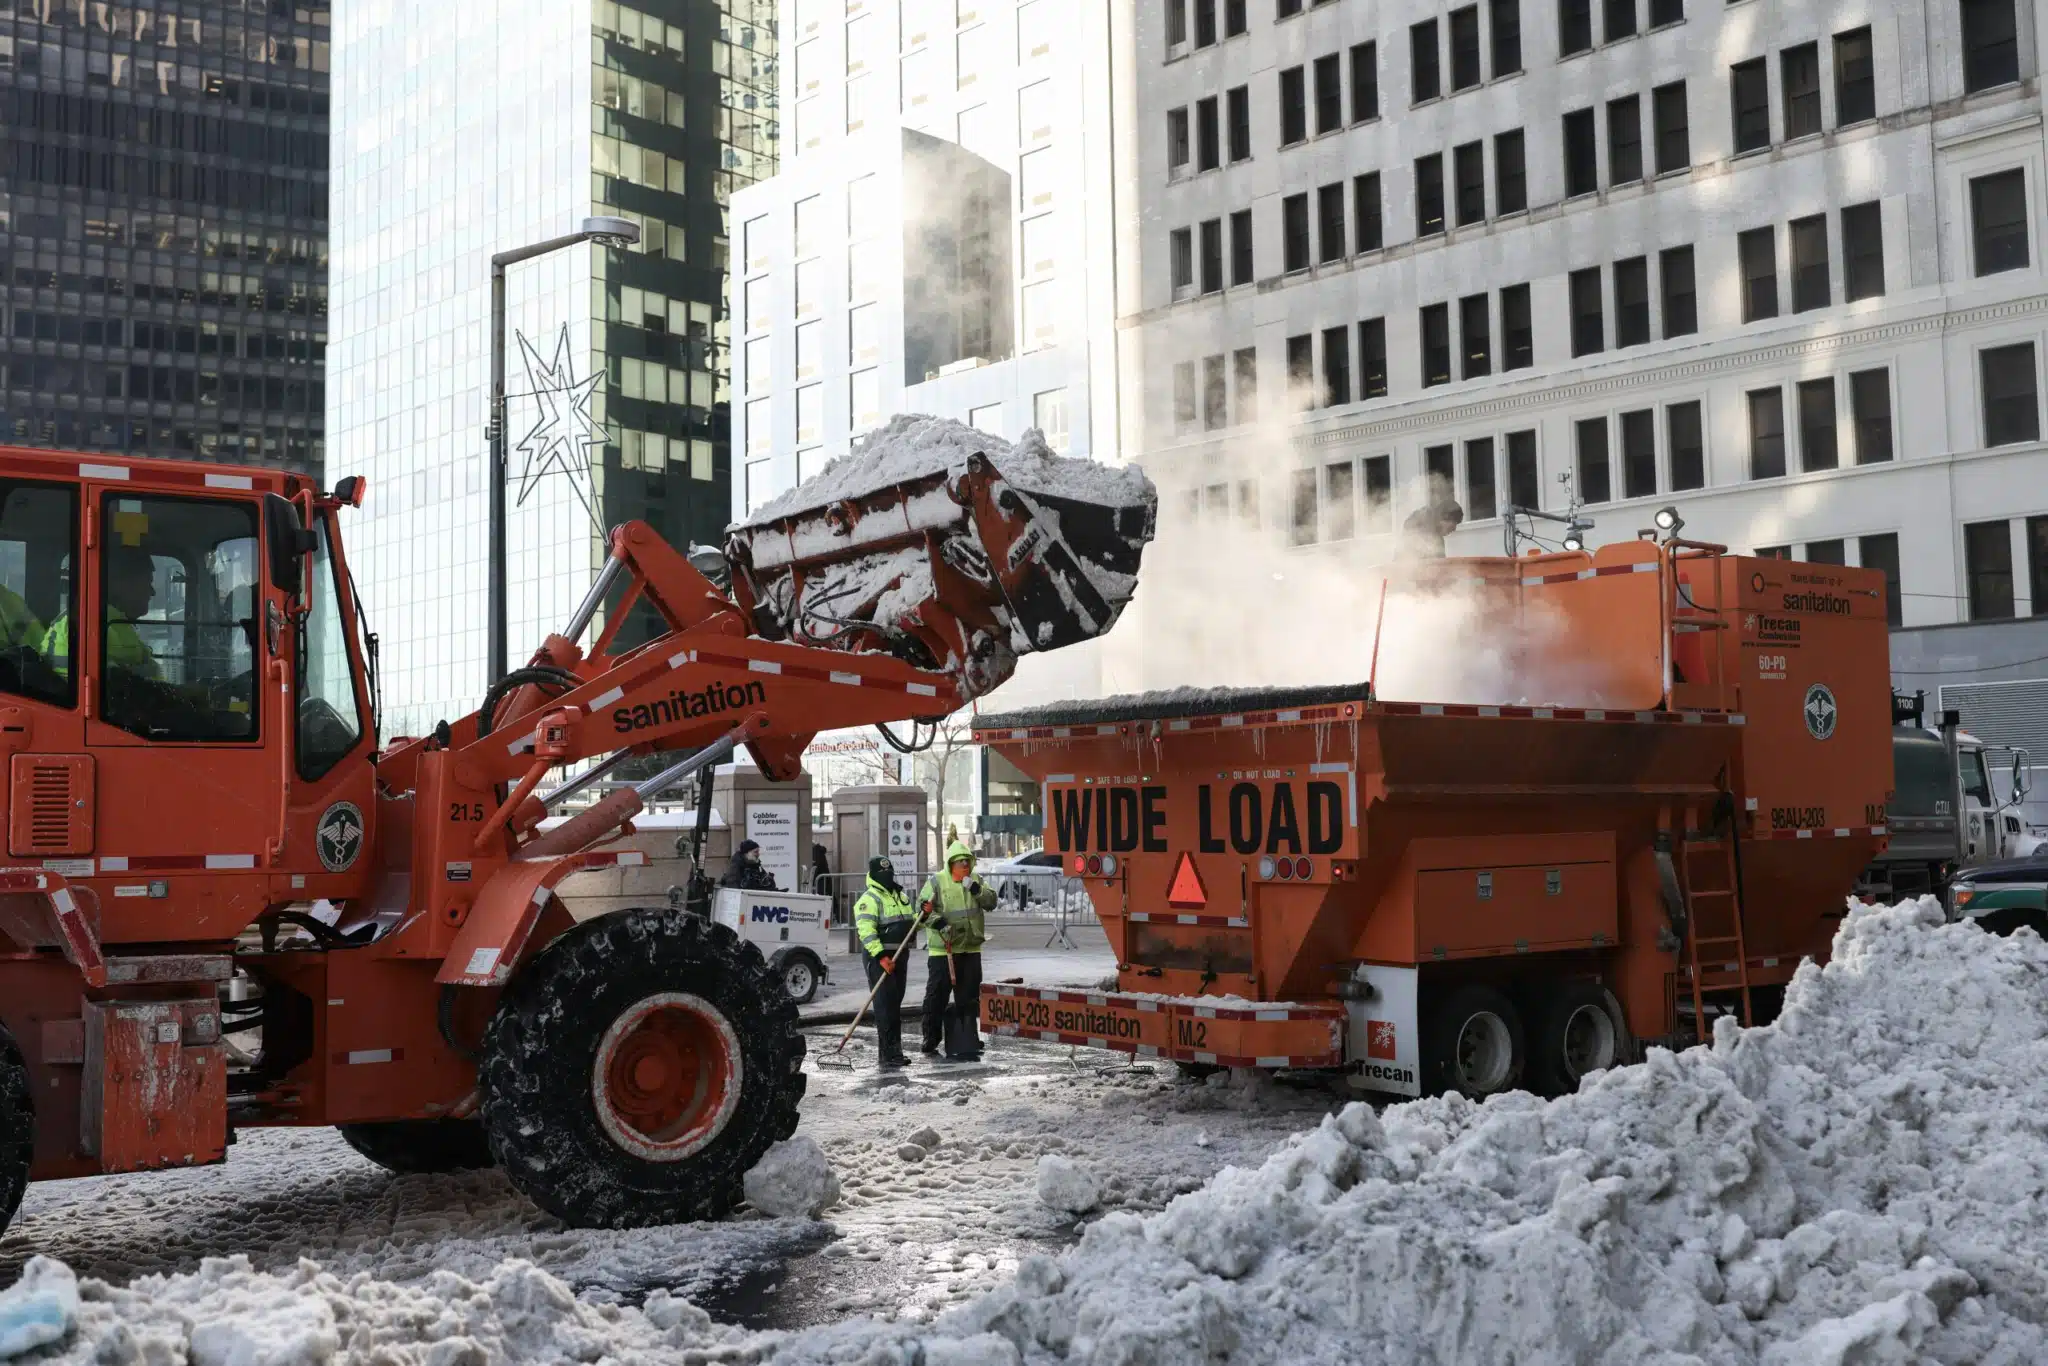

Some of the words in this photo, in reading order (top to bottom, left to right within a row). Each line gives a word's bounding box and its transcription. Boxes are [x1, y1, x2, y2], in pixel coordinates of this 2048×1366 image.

[1783, 591, 1850, 614] sanitation
[1757, 614, 1800, 632] Trecan
[1758, 655, 1786, 670] 60-PD
[613, 680, 767, 733] sanitation
[1123, 775, 1138, 784] LOAD
[1246, 771, 1259, 779] NOT
[1263, 769, 1281, 779] LOAD
[450, 803, 484, 822] 21.5
[1052, 785, 1168, 853] WIDE
[1198, 781, 1344, 855] LOAD
[1771, 806, 1826, 829] 96AU-203
[1865, 804, 1884, 825] M.2
[752, 905, 790, 923] NYC
[789, 910, 815, 918] Emergency
[988, 997, 1050, 1028] 96AU-203
[1054, 1009, 1141, 1040] sanitation
[1178, 1019, 1207, 1049] M.2
[1355, 1059, 1414, 1083] Trecan
